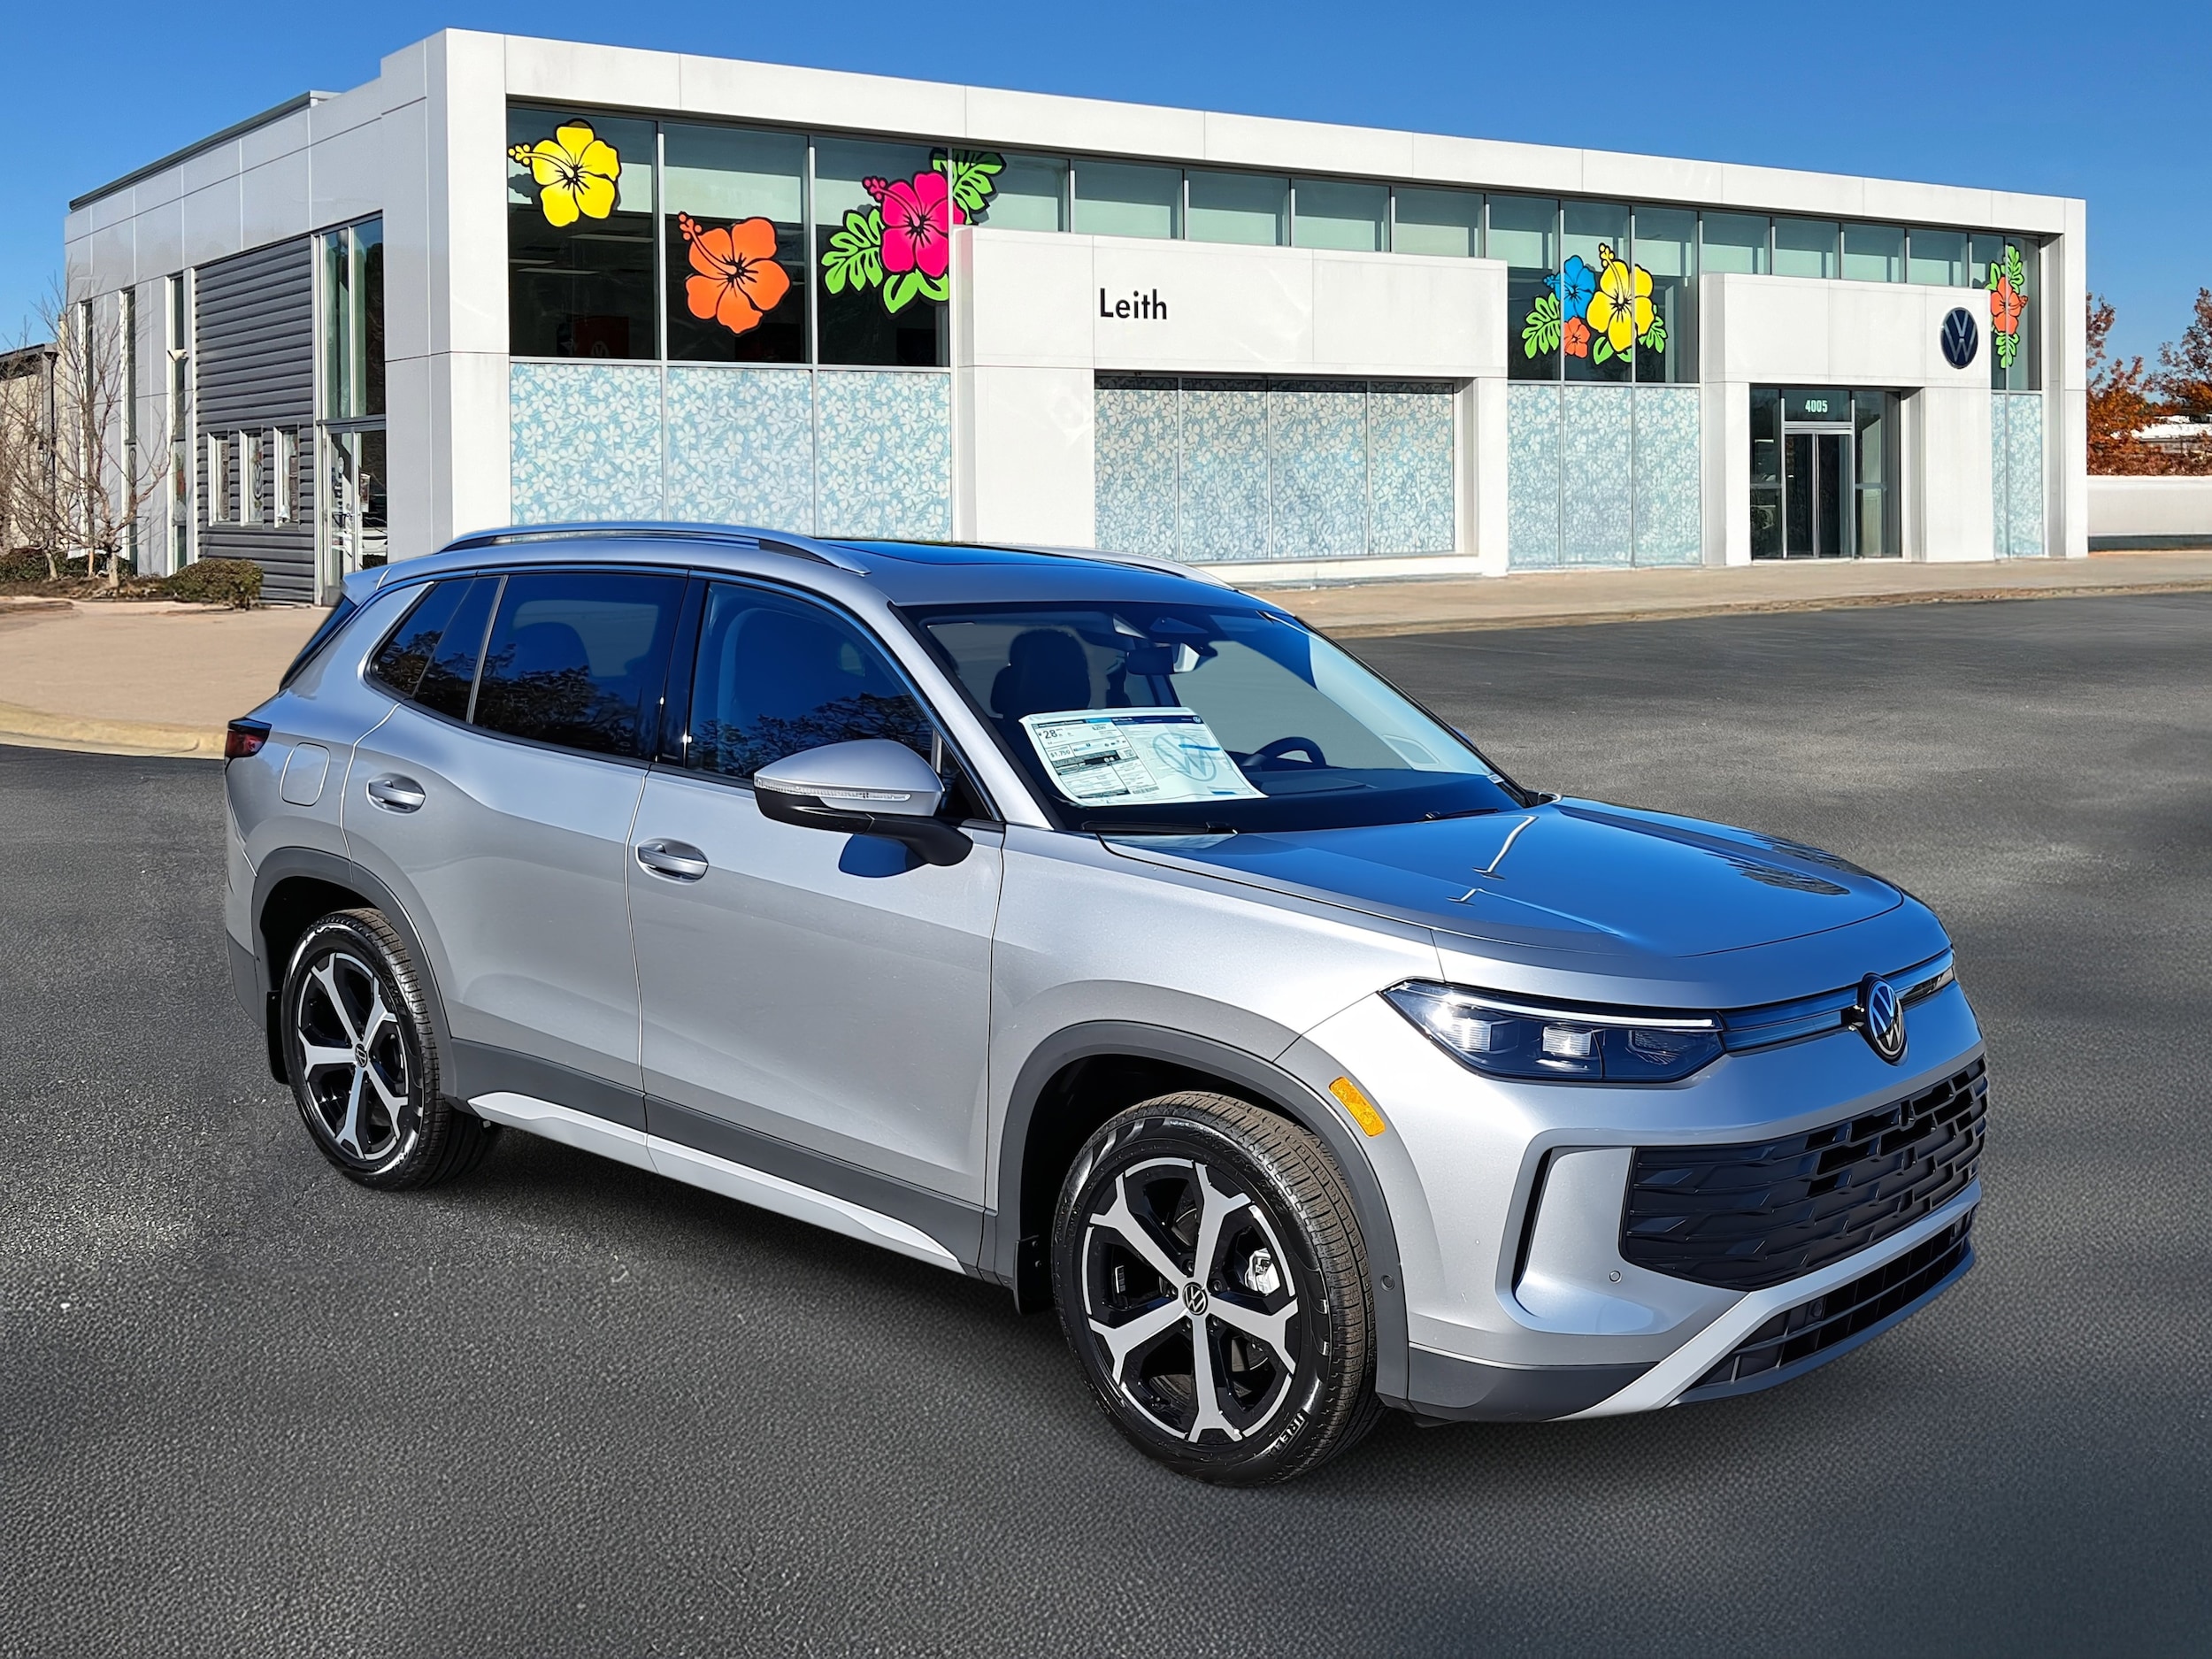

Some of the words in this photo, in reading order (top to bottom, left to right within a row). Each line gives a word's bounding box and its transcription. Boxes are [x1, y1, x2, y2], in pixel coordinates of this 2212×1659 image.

[1100, 288, 1167, 319] Leith
[1805, 399, 1828, 413] 4005
[1042, 728, 1058, 740] 28
